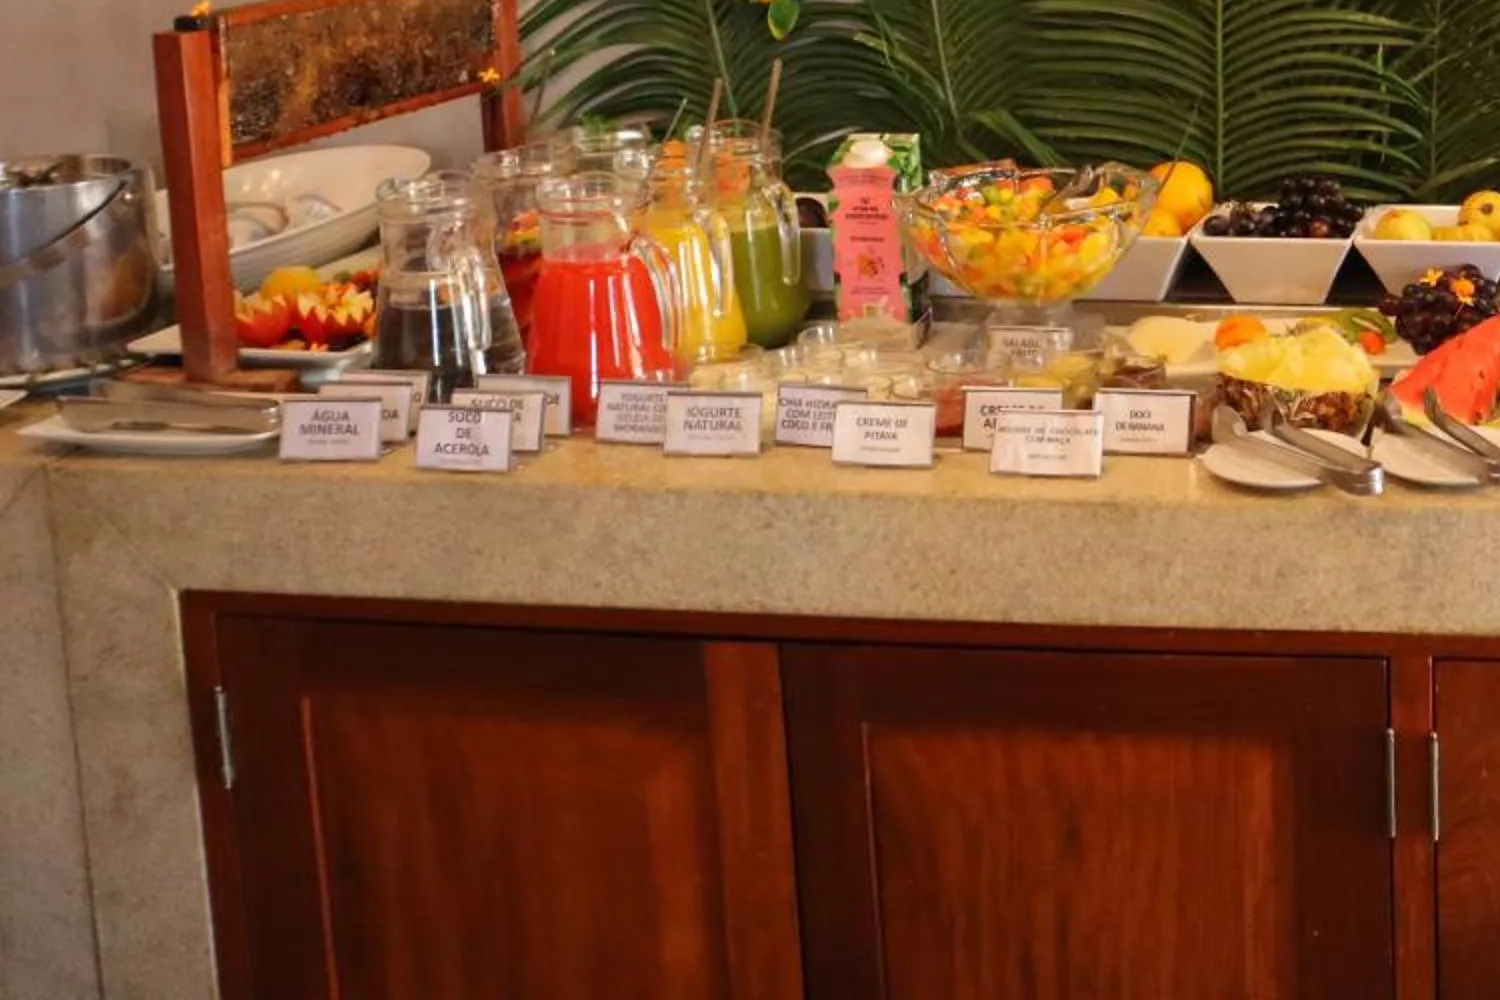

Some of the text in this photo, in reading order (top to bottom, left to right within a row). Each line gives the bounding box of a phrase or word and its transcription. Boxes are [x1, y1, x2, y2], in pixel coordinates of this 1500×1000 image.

[311, 407, 351, 423] ÁGUA
[447, 411, 481, 424] SUCO
[686, 406, 742, 419] IOGURTE
[299, 423, 359, 436] MINERAL
[683, 419, 743, 432] NATURAL
[455, 427, 472, 439] DE
[434, 442, 489, 457] ACEROLA
